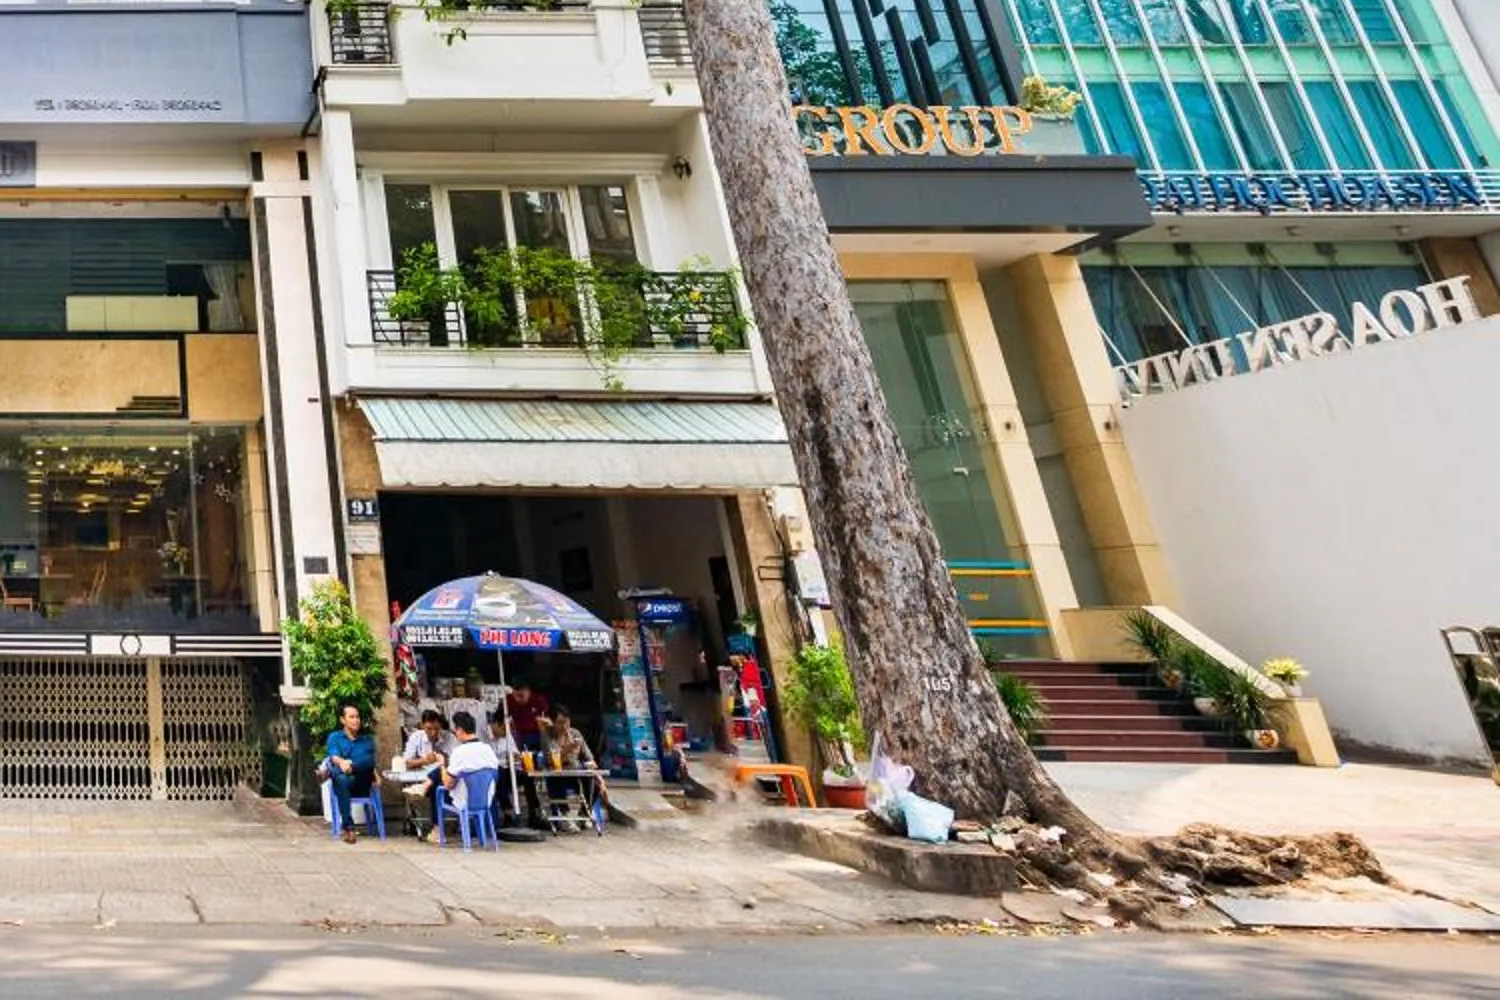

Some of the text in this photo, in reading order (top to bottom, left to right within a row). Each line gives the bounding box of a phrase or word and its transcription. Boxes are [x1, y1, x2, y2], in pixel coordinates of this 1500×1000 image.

[791, 104, 1032, 157] GROUP
[351, 501, 375, 515] 91
[510, 629, 552, 648] LONG
